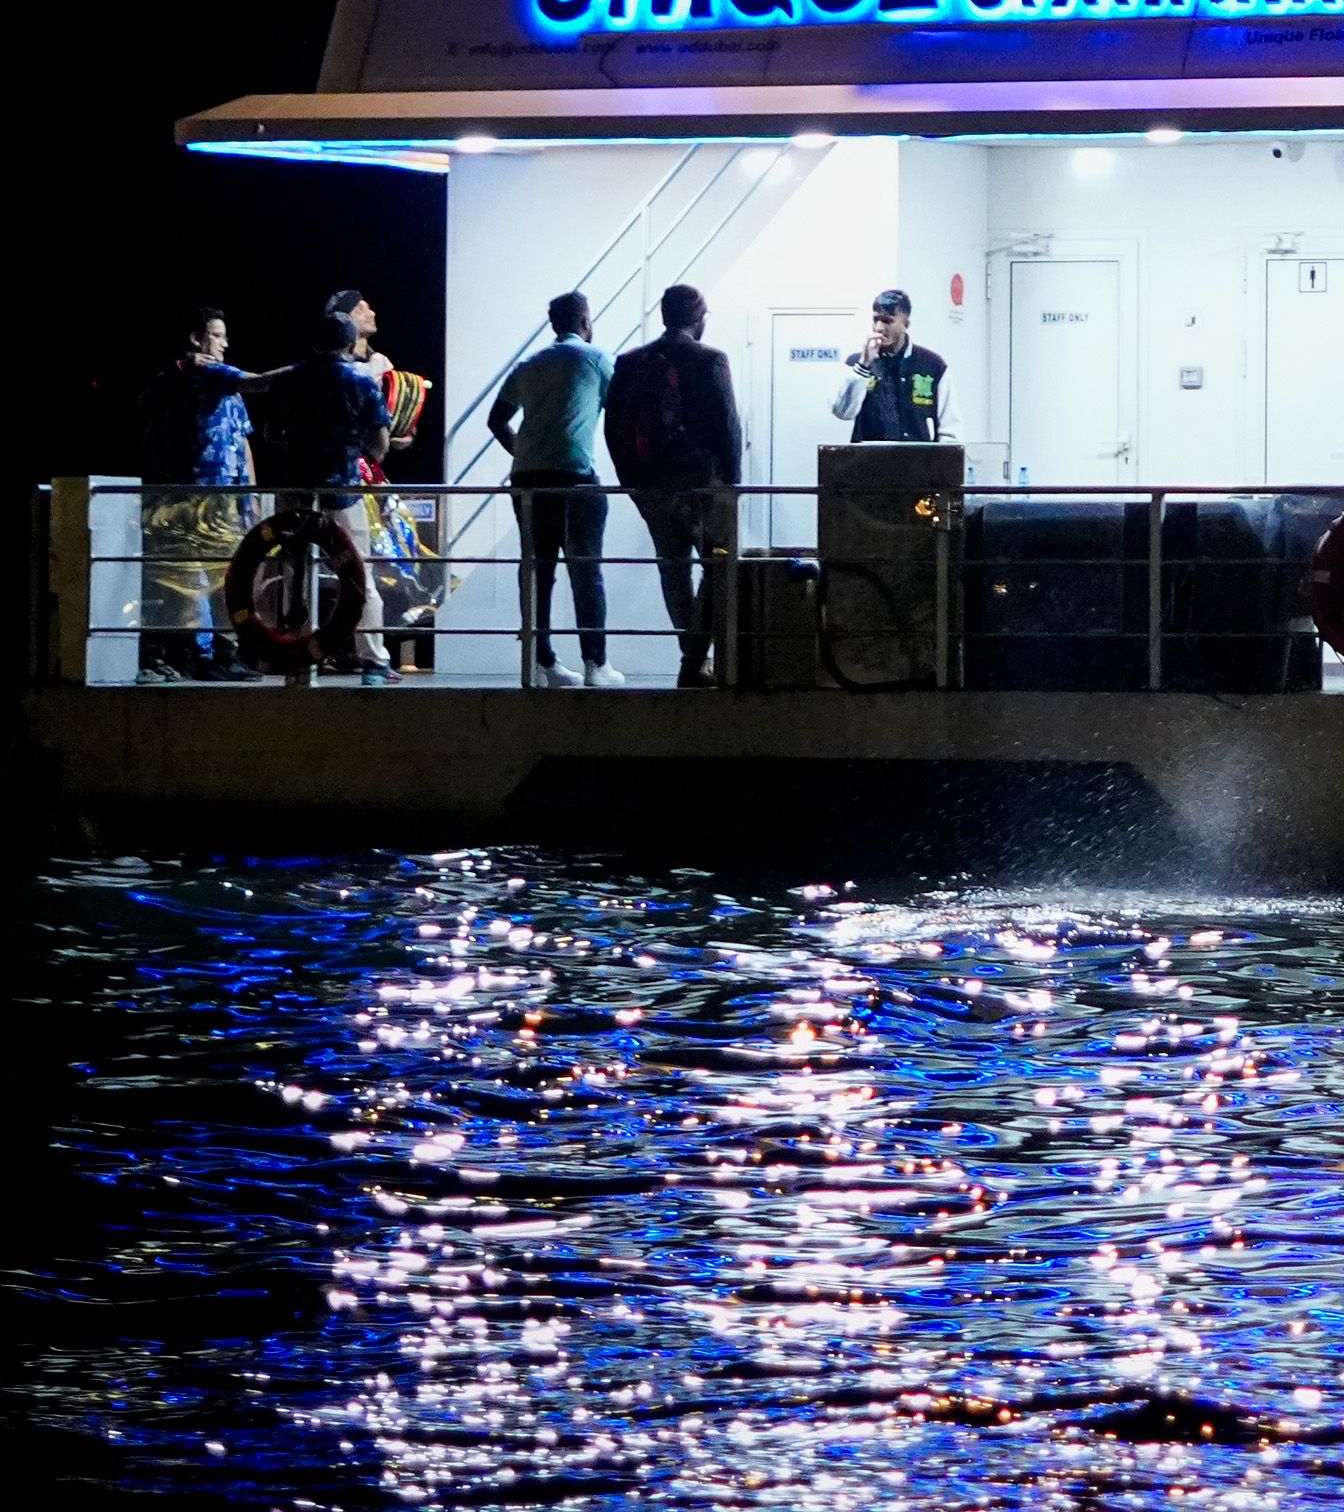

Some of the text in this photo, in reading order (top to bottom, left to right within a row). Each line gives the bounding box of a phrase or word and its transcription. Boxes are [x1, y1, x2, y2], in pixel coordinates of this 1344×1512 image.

[1246, 31, 1304, 46] Unique
[1042, 312, 1089, 323] STAFF ONLY
[791, 349, 814, 359] STAFF
